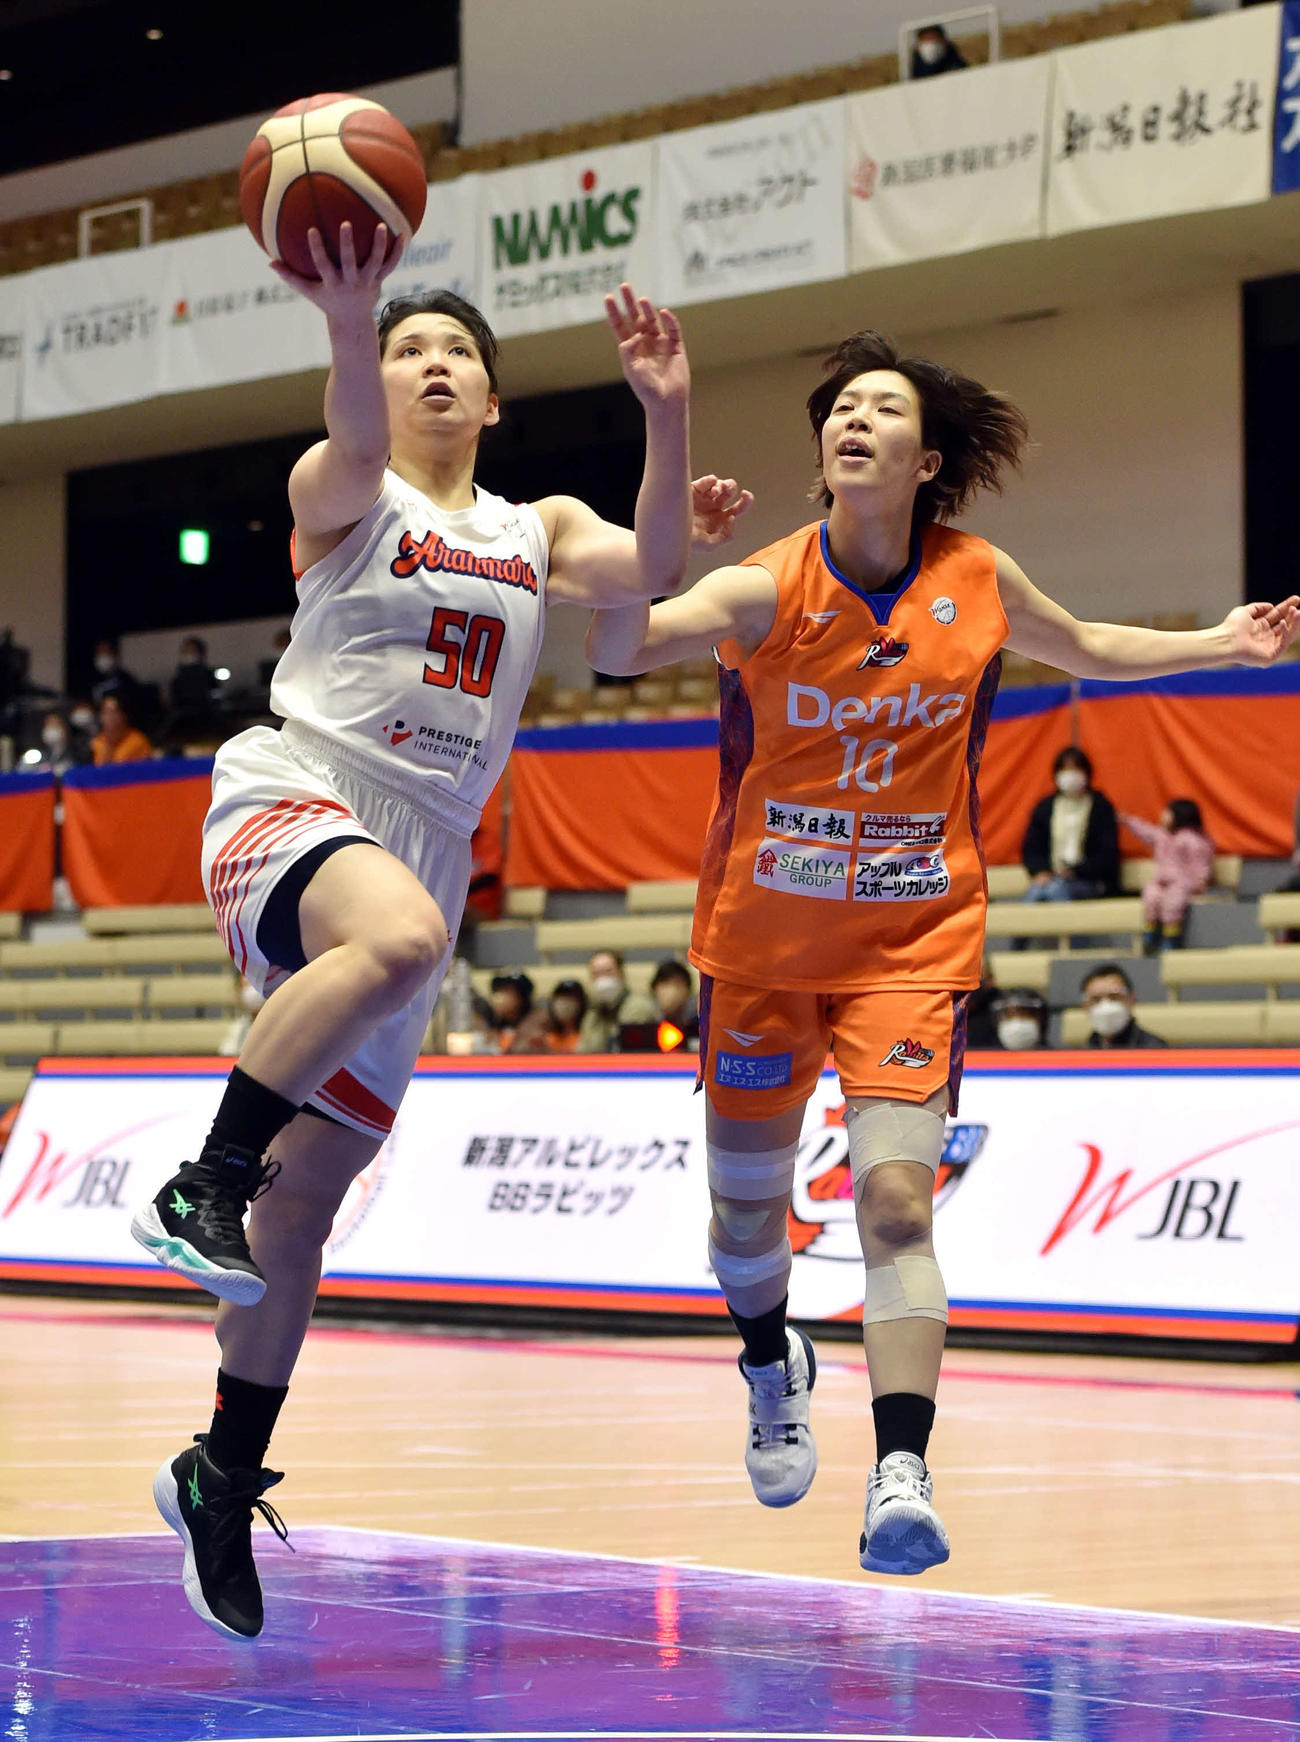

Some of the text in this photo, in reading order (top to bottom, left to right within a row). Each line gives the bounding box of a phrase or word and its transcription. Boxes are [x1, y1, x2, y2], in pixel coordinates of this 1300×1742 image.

[422, 606, 506, 699] 50
[786, 681, 967, 732] Denka
[418, 726, 482, 750] PRESTIGE
[413, 740, 489, 771] INTERNATINAL
[836, 734, 899, 794] 10
[766, 806, 851, 840] 新潟日報
[863, 824, 929, 838] Rabbit
[778, 853, 846, 877] SEKIYA
[788, 873, 833, 888] GROUP
[854, 875, 949, 898] スポーツカレッジ
[463, 1135, 690, 1170] 新潟アルビレックス
